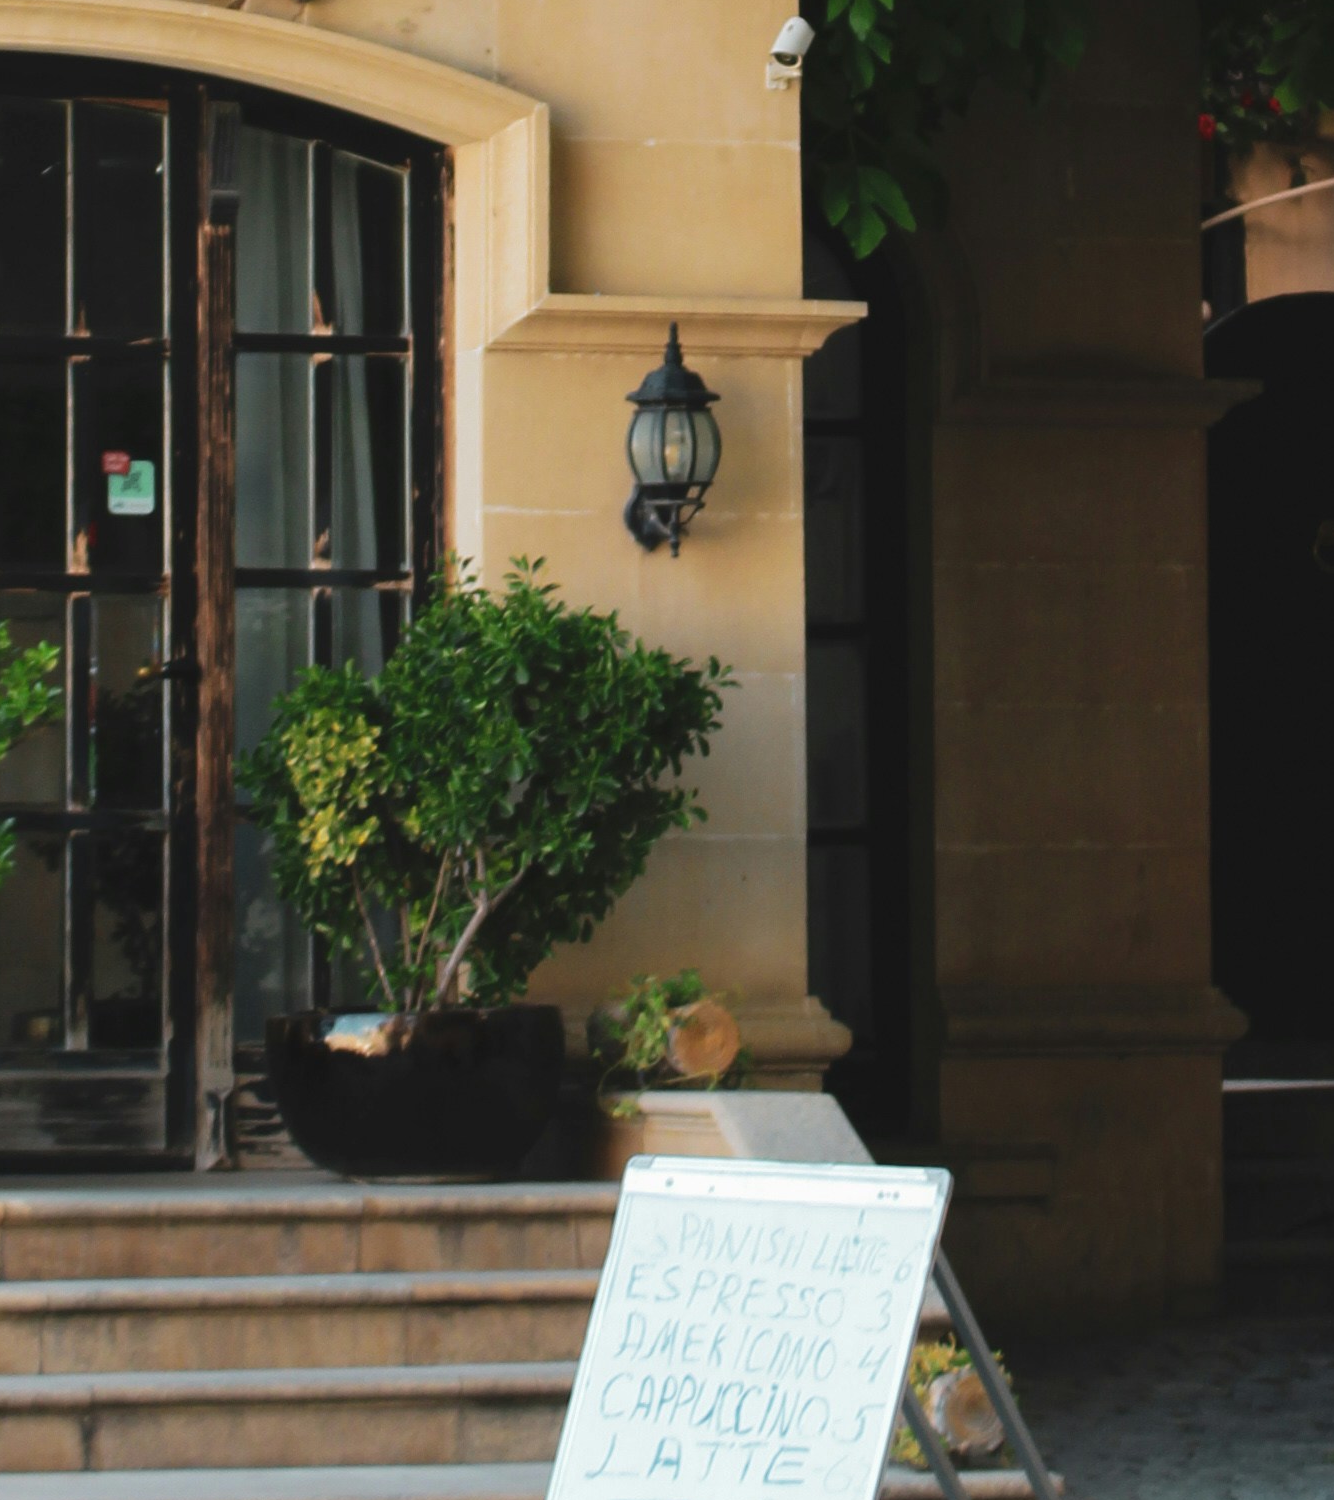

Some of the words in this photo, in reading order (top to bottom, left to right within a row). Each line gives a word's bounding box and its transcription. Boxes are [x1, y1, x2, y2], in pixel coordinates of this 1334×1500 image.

[626, 1262, 846, 1328] ESPRESSO
[615, 1311, 837, 1382] AMERICANO
[600, 1372, 830, 1438] CAPPUCCINO
[585, 1433, 810, 1485] LATTE
